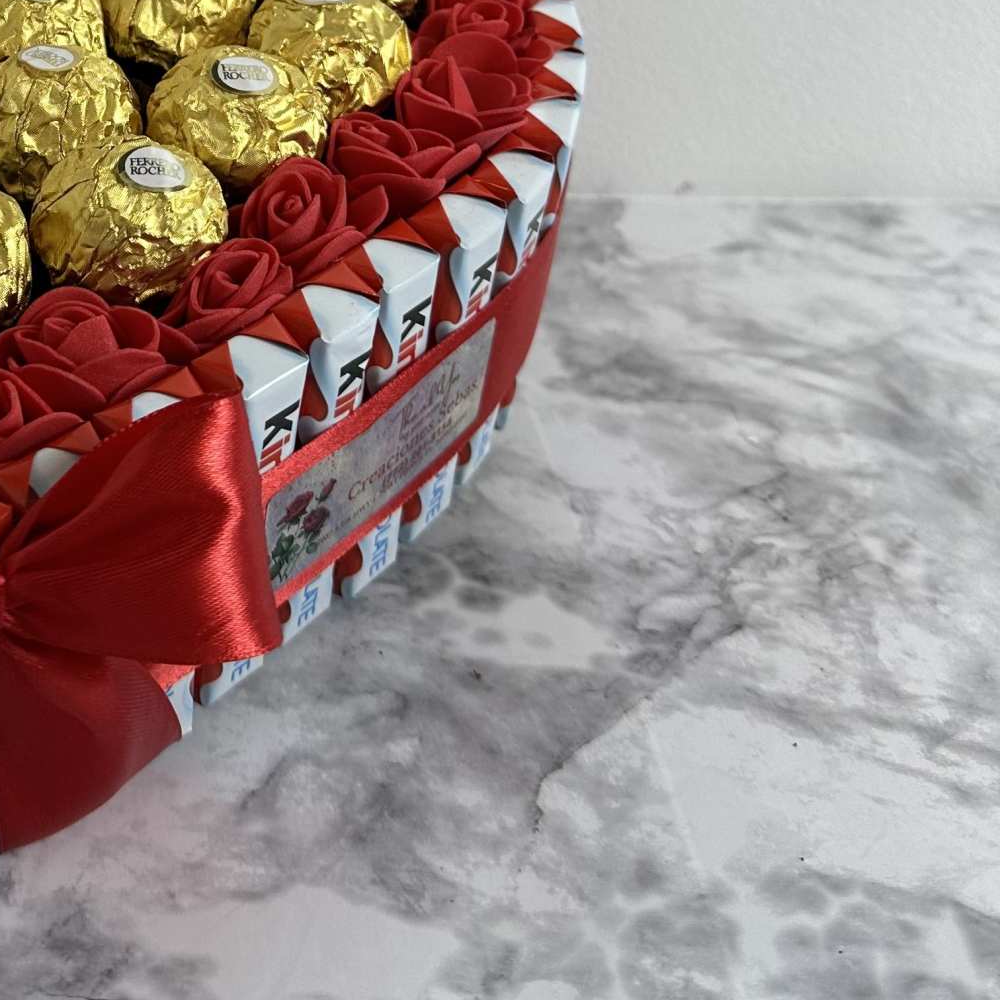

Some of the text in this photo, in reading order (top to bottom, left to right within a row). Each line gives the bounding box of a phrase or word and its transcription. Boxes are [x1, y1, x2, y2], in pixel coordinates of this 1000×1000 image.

[221, 63, 269, 75] FERRERO
[223, 71, 271, 83] ROCHER
[129, 157, 182, 172] FERRERO
[129, 166, 182, 181] ROCHER
